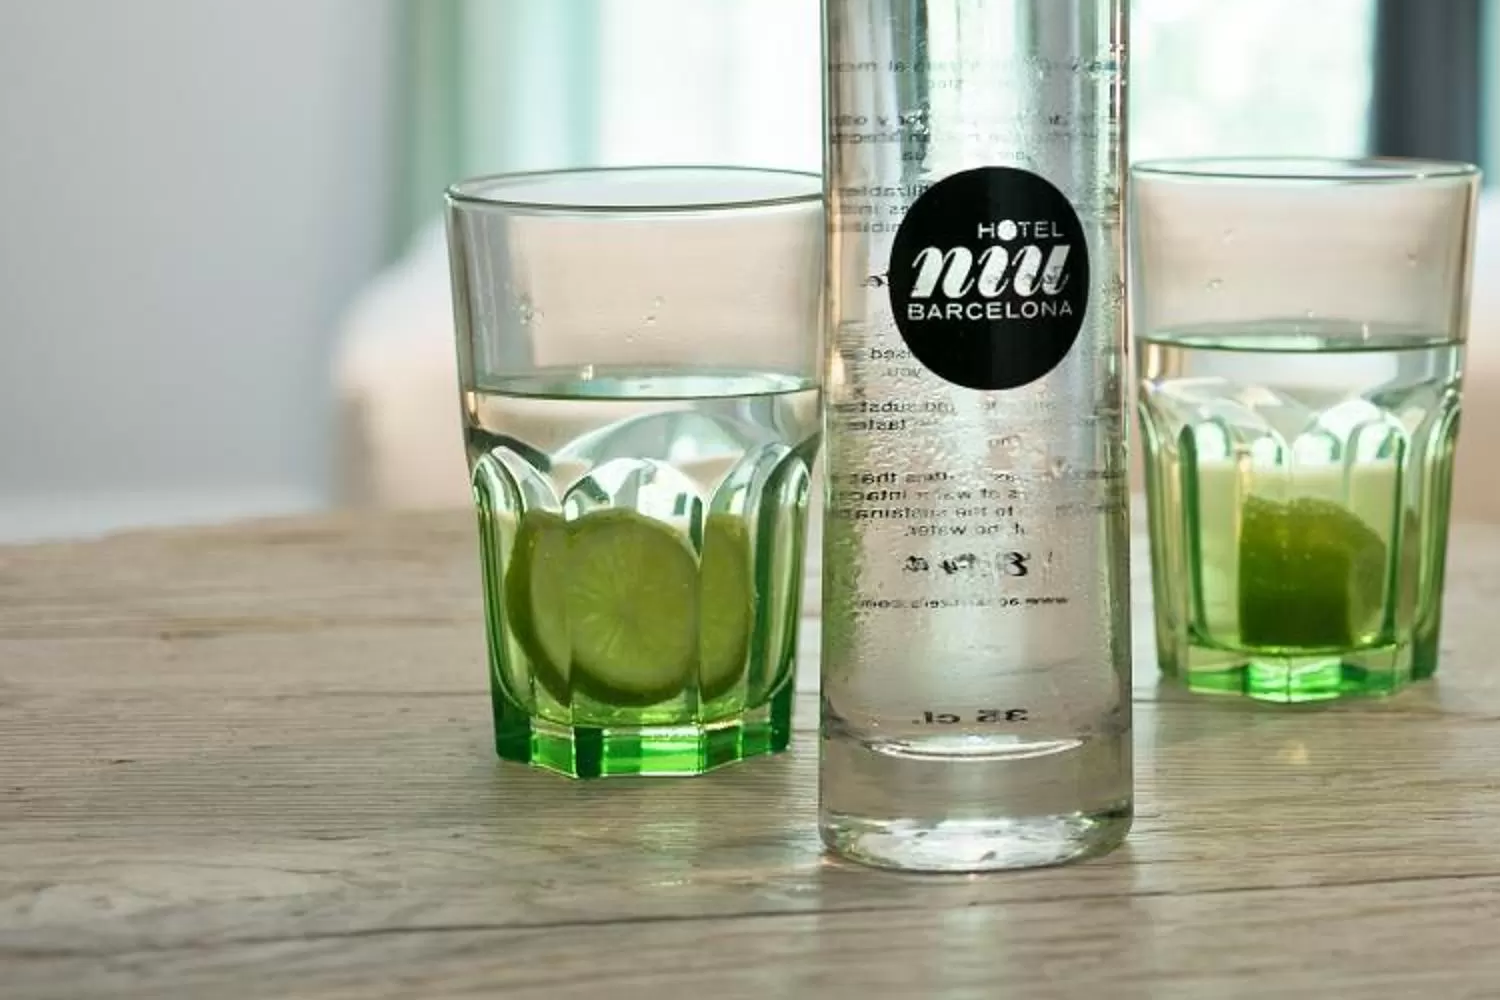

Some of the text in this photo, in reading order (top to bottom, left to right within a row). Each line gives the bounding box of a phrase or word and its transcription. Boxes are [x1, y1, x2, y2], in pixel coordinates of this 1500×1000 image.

[976, 218, 1065, 242] HOTEL
[909, 243, 1072, 299] niu
[906, 300, 1074, 321] BARCELONA
